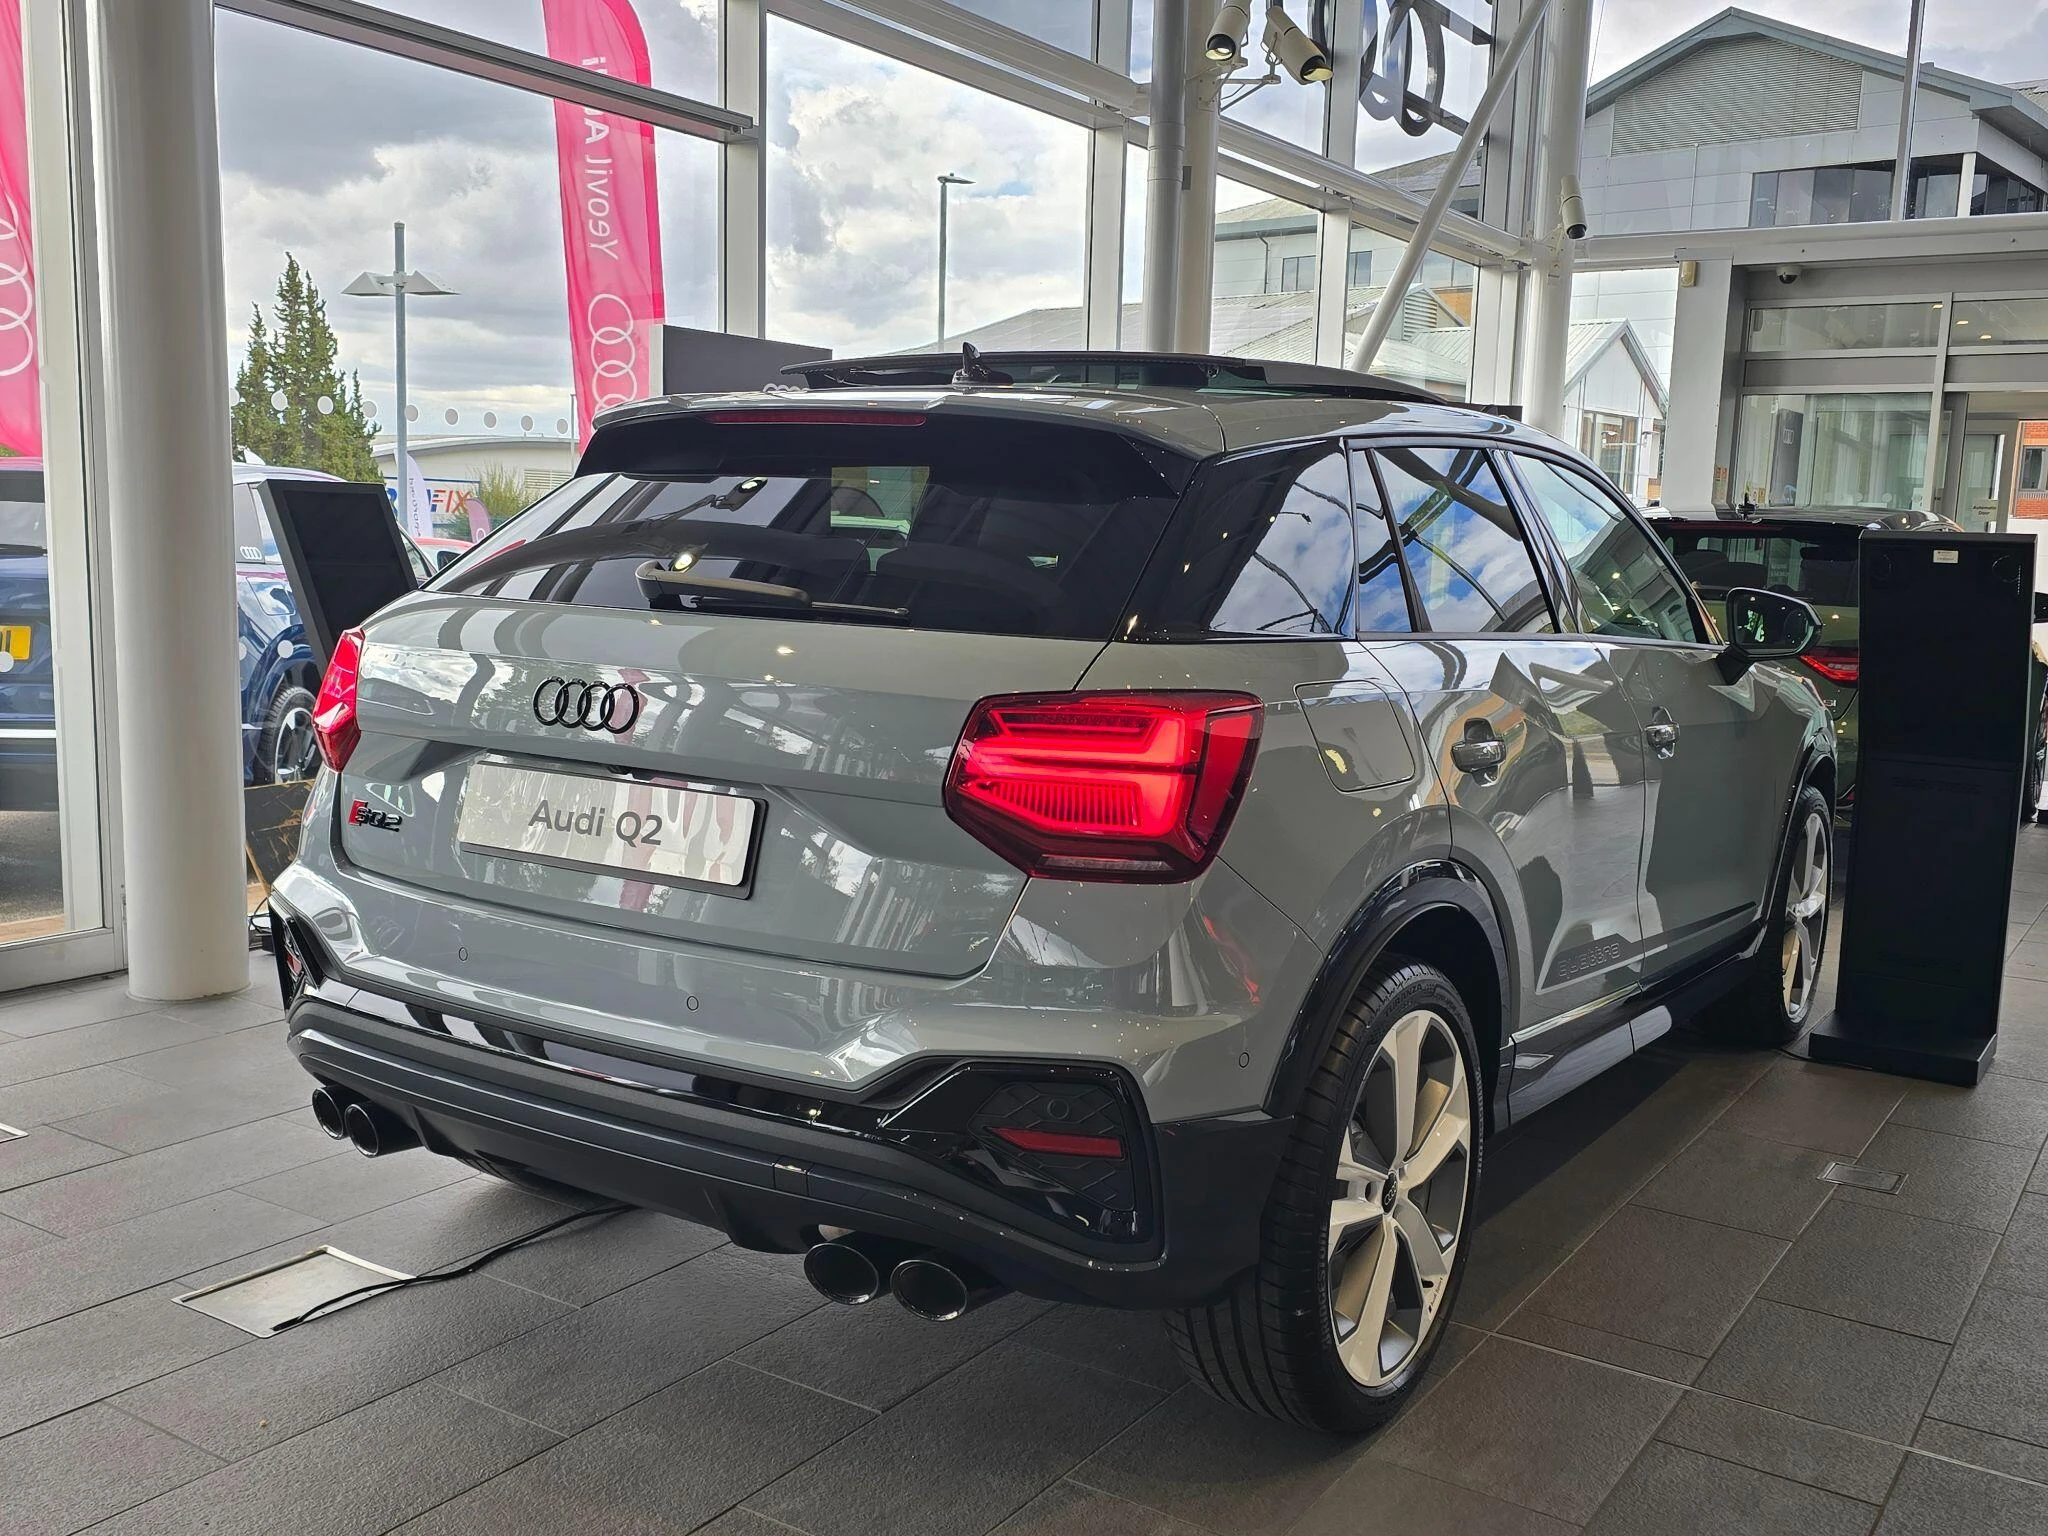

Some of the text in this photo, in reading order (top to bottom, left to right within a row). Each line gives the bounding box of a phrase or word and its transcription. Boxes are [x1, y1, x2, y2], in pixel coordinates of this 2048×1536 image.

[350, 801, 403, 832] SQ2
[528, 799, 663, 848] Audi Q2
